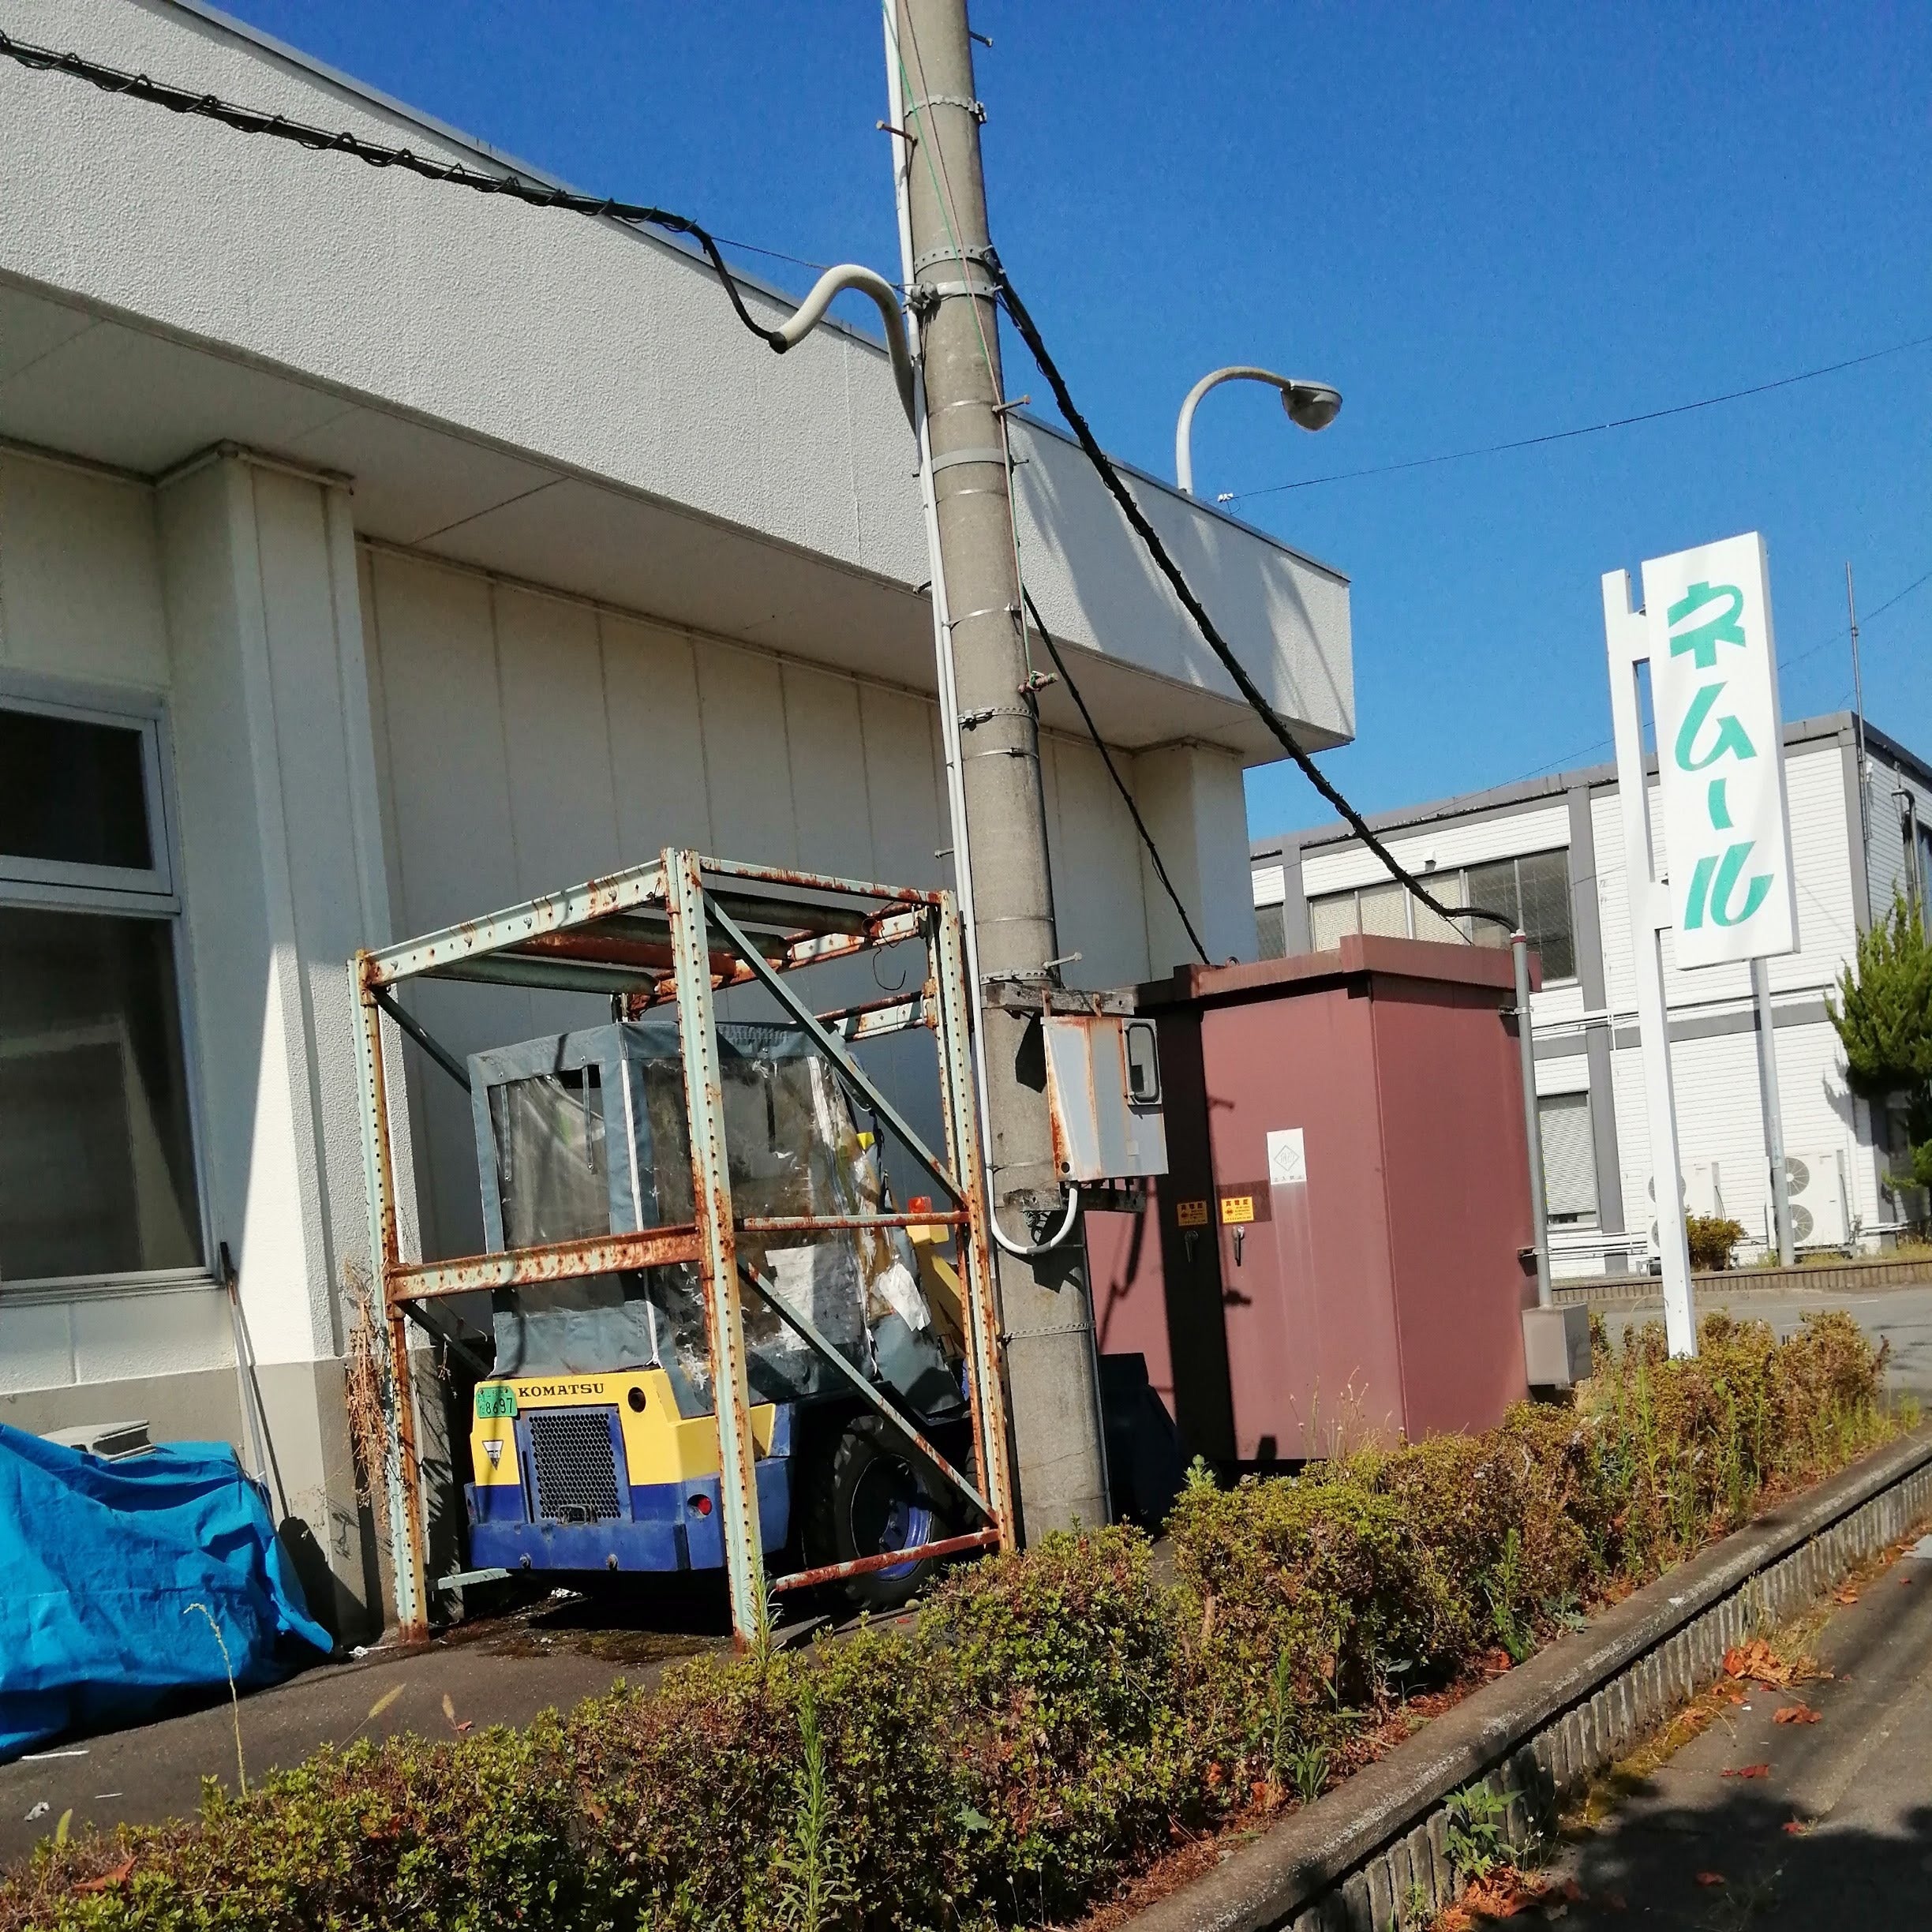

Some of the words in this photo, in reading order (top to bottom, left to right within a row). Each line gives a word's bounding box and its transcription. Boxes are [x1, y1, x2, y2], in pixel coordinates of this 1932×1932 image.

[1667, 580, 1774, 930] ネムール
[518, 1383, 605, 1398] KOMATSU
[485, 1397, 513, 1415] 8697
